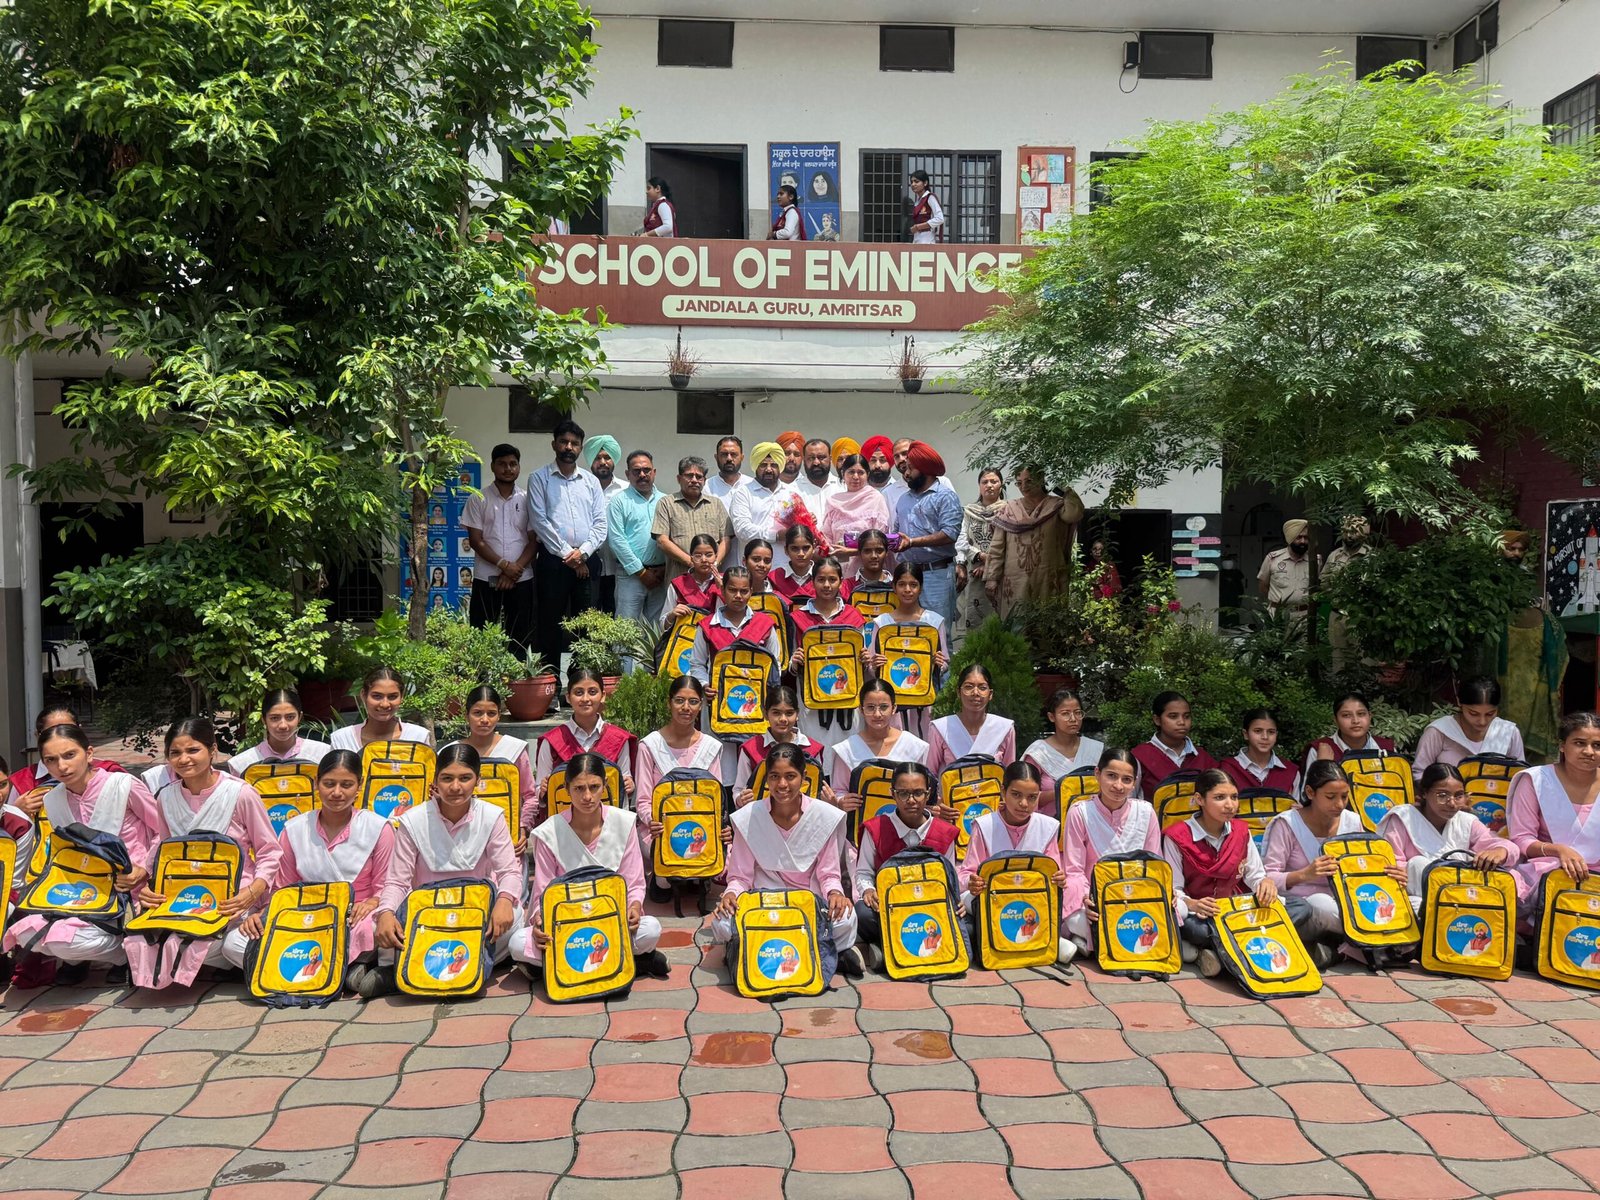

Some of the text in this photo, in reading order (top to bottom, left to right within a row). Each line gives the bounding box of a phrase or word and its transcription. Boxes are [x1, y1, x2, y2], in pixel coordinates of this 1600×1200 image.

[772, 149, 791, 161] ਸਕੂਲ
[792, 146, 799, 158] ਦੇ
[799, 149, 814, 158] ਚਾਰ
[537, 242, 1023, 293] SCHOOL OF EMINENCE
[675, 299, 903, 317] JANDIALA GURU, AMRITSAR
[1554, 541, 1575, 566] PURSUIT
[1576, 537, 1583, 548] OF
